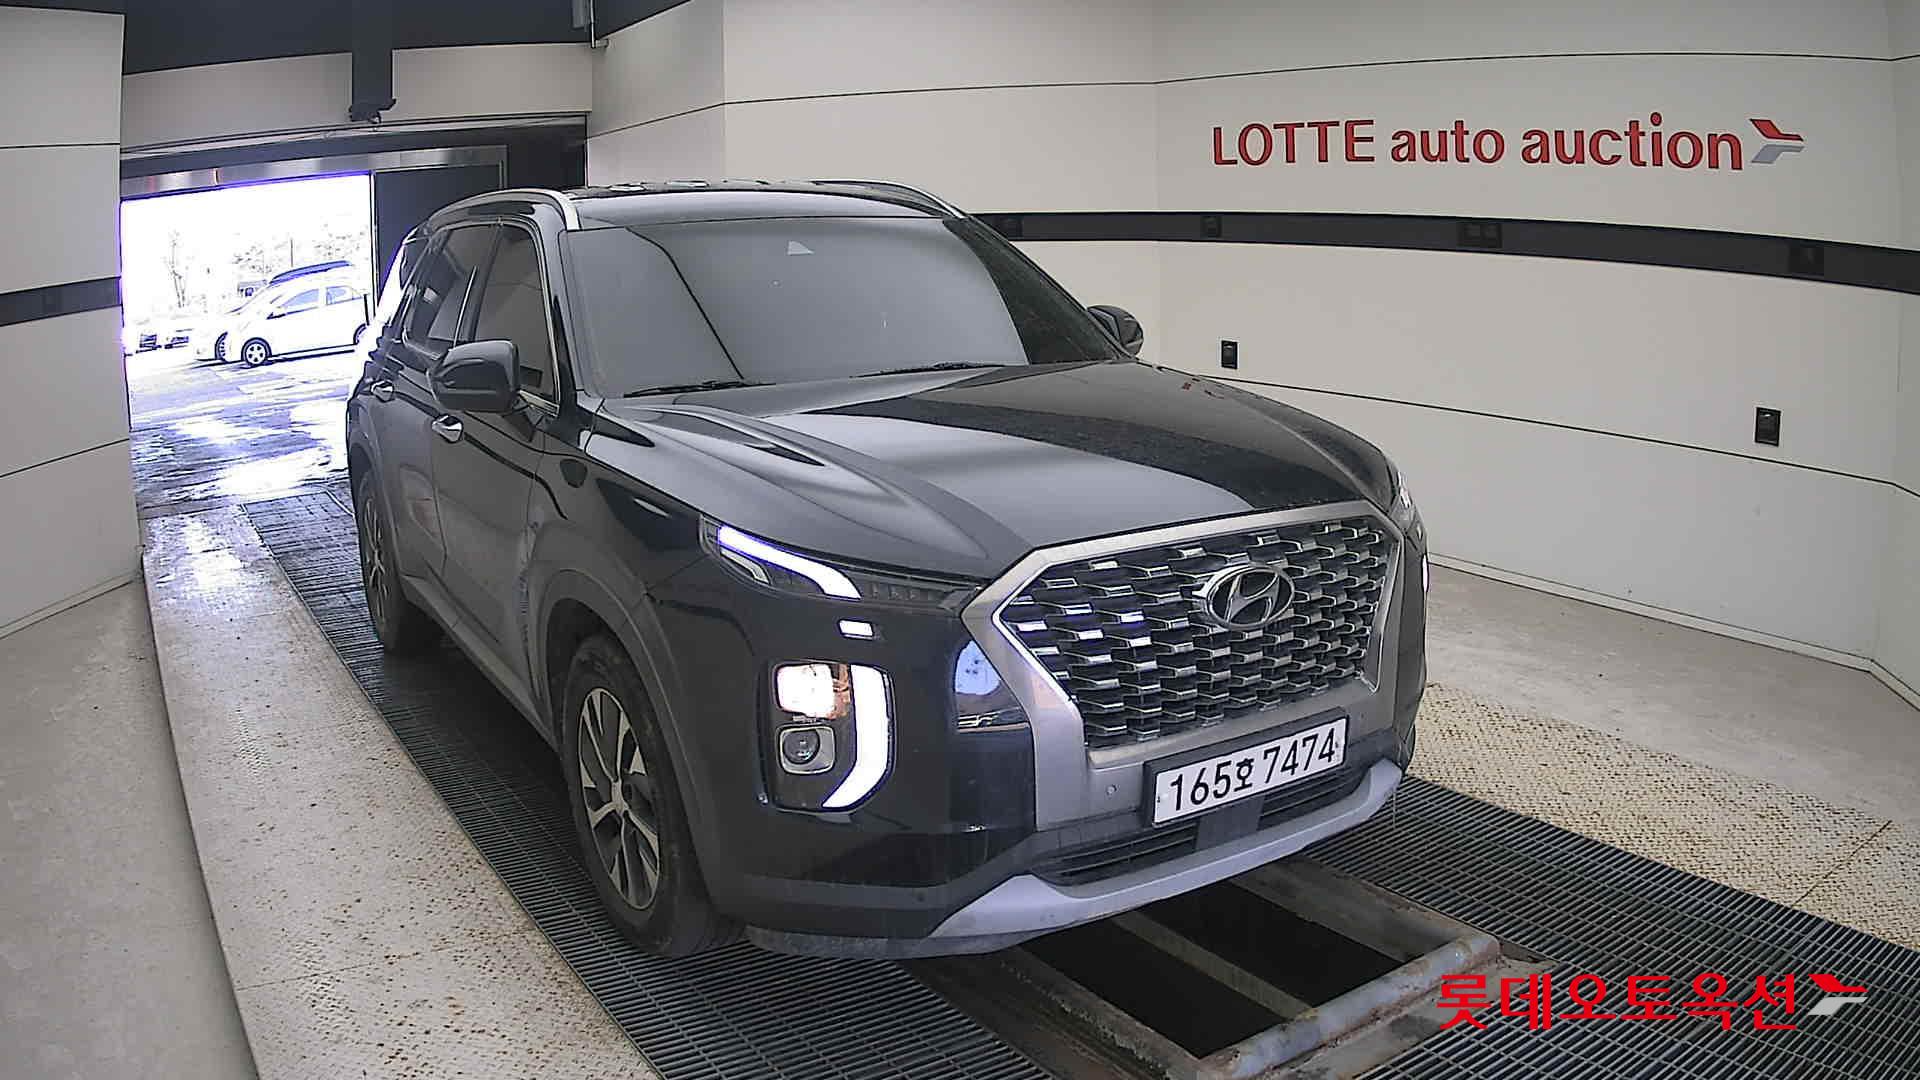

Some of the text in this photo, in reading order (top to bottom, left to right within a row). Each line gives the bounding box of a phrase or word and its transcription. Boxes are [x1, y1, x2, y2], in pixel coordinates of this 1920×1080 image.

[1212, 112, 1743, 171] LOTTE auto auction
[1170, 727, 1336, 811] 165호 7474
